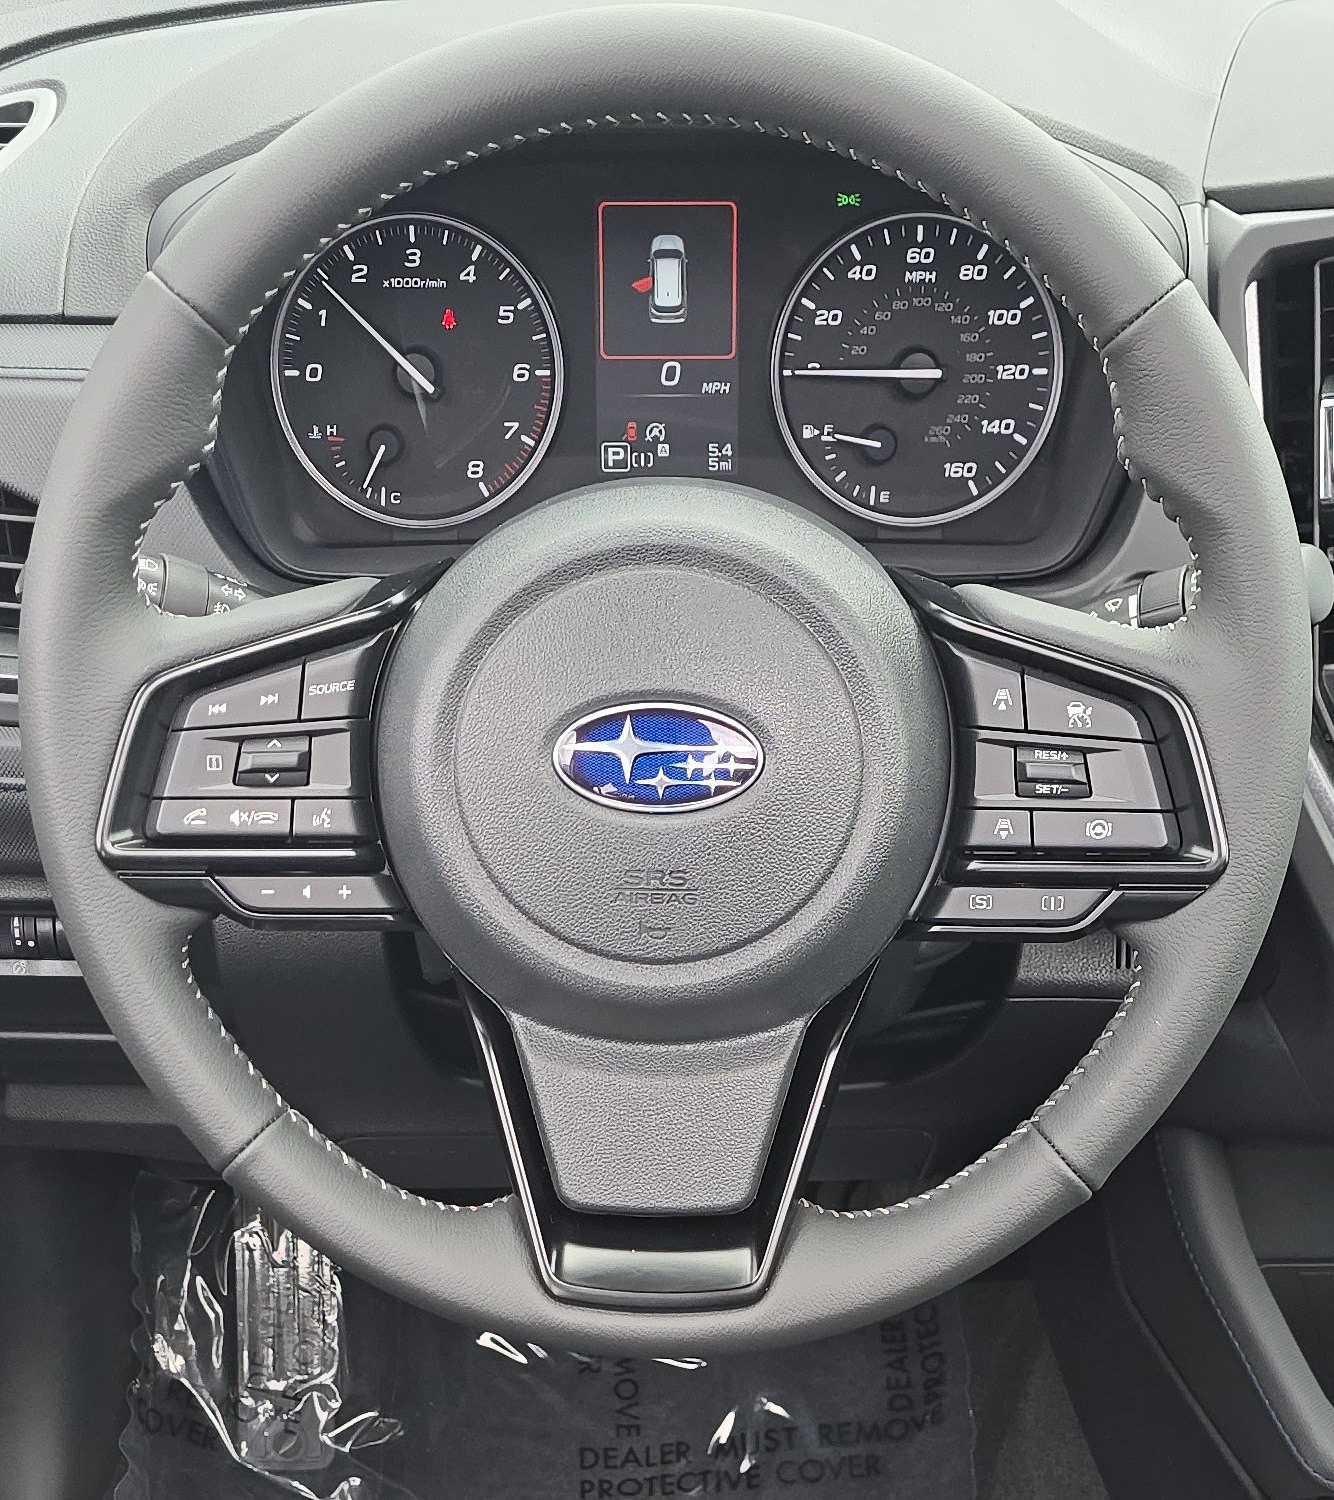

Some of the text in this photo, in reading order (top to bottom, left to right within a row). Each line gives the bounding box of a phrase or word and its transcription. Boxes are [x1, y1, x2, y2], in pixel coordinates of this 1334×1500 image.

[404, 249, 421, 267] 3
[906, 248, 935, 263] 60
[351, 265, 368, 282] 2
[460, 265, 477, 283] 4
[847, 265, 877, 281] 40
[905, 271, 936, 283] MPH
[959, 265, 988, 281] 80
[382, 277, 447, 289] x1000r/min
[892, 300, 909, 310] 80
[912, 297, 932, 307] 100
[934, 302, 954, 312] 120
[318, 310, 327, 327] 1
[497, 306, 515, 324] 5
[814, 310, 842, 326] 20
[874, 311, 892, 321] 60
[950, 315, 971, 325] 140
[987, 309, 1021, 325] 100
[859, 326, 877, 336] 40
[959, 333, 980, 343] 160
[851, 345, 868, 355] 20
[966, 353, 985, 362] 180
[305, 364, 323, 382] 0
[512, 364, 530, 382] 6
[660, 361, 681, 386] 0
[962, 374, 986, 384] 200
[996, 364, 1029, 380] 120
[701, 382, 730, 394] MPH
[956, 394, 980, 404] 220
[946, 414, 970, 424] 240
[326, 425, 337, 436] H
[503, 422, 520, 439] 7
[823, 425, 834, 436] F
[981, 419, 1015, 435] 140
[708, 443, 733, 456] 5.4
[467, 460, 484, 478] 8
[944, 462, 978, 478] 160
[390, 492, 401, 504] C
[879, 491, 890, 502] E
[308, 680, 356, 696] SOURCE
[623, 869, 687, 887] SRS
[579, 1440, 691, 1470] DEALER
[714, 1426, 798, 1459] MUST
[579, 1454, 882, 1500] PROTECTIVE COVER
